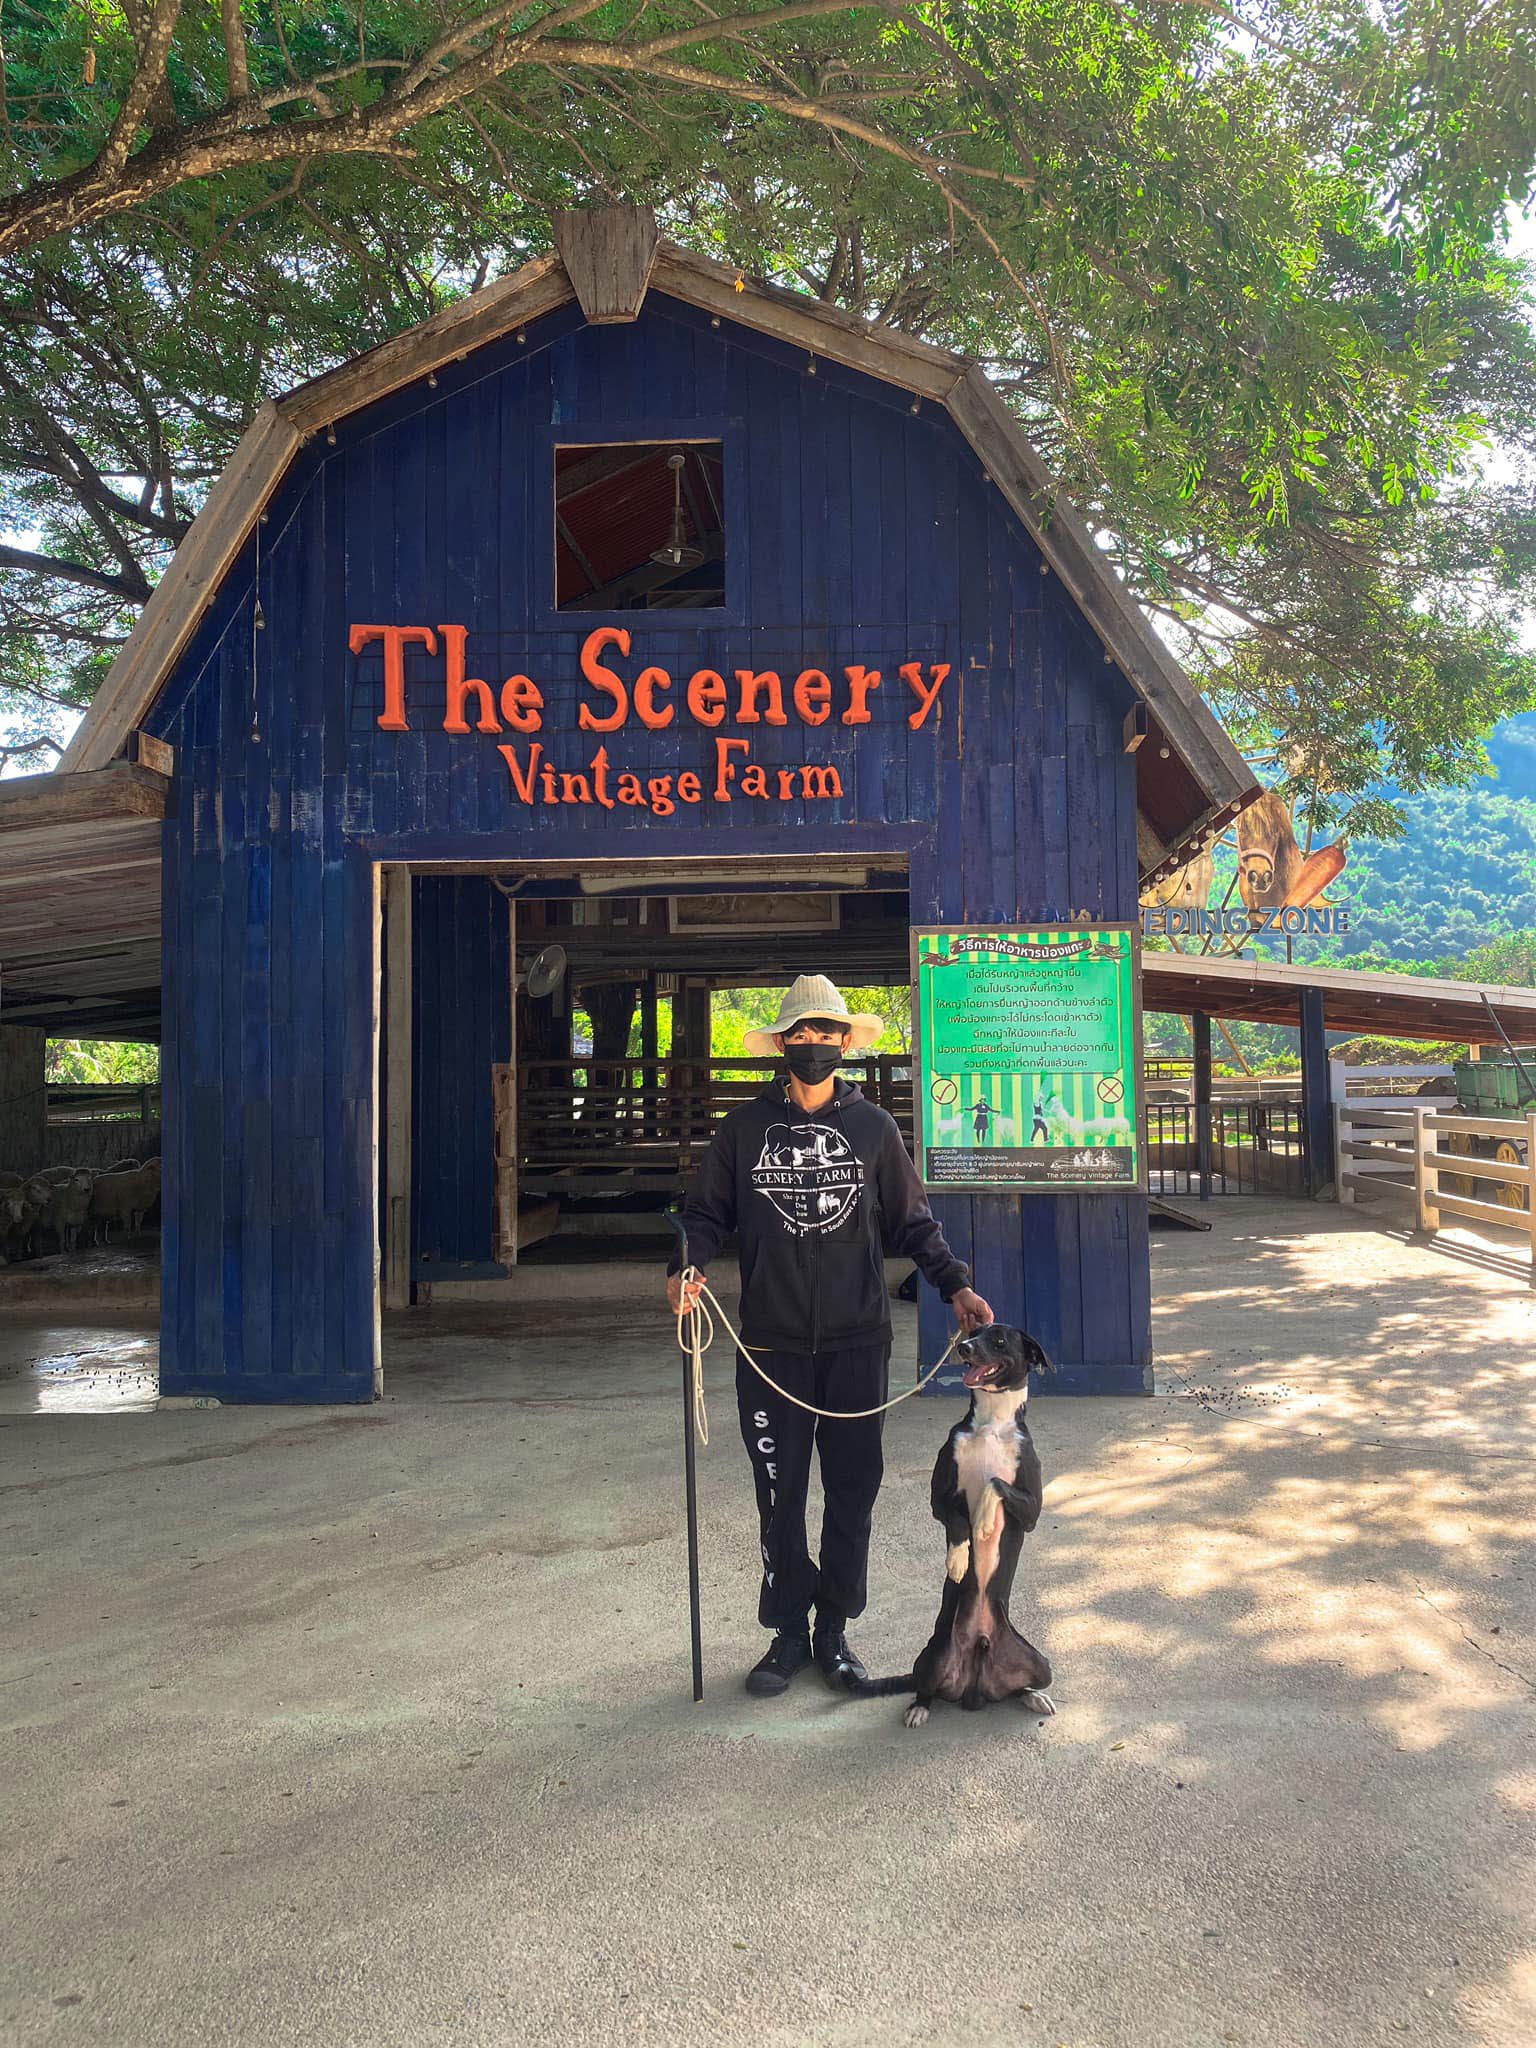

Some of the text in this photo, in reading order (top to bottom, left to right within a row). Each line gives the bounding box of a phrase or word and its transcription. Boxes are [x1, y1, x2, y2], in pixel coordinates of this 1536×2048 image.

[349, 624, 952, 734] The Scenery
[498, 737, 845, 815] Vintage Farm
[1139, 906, 1351, 937] EDING ZONE
[816, 1168, 851, 1183] FARM
[783, 1221, 797, 1235] The
